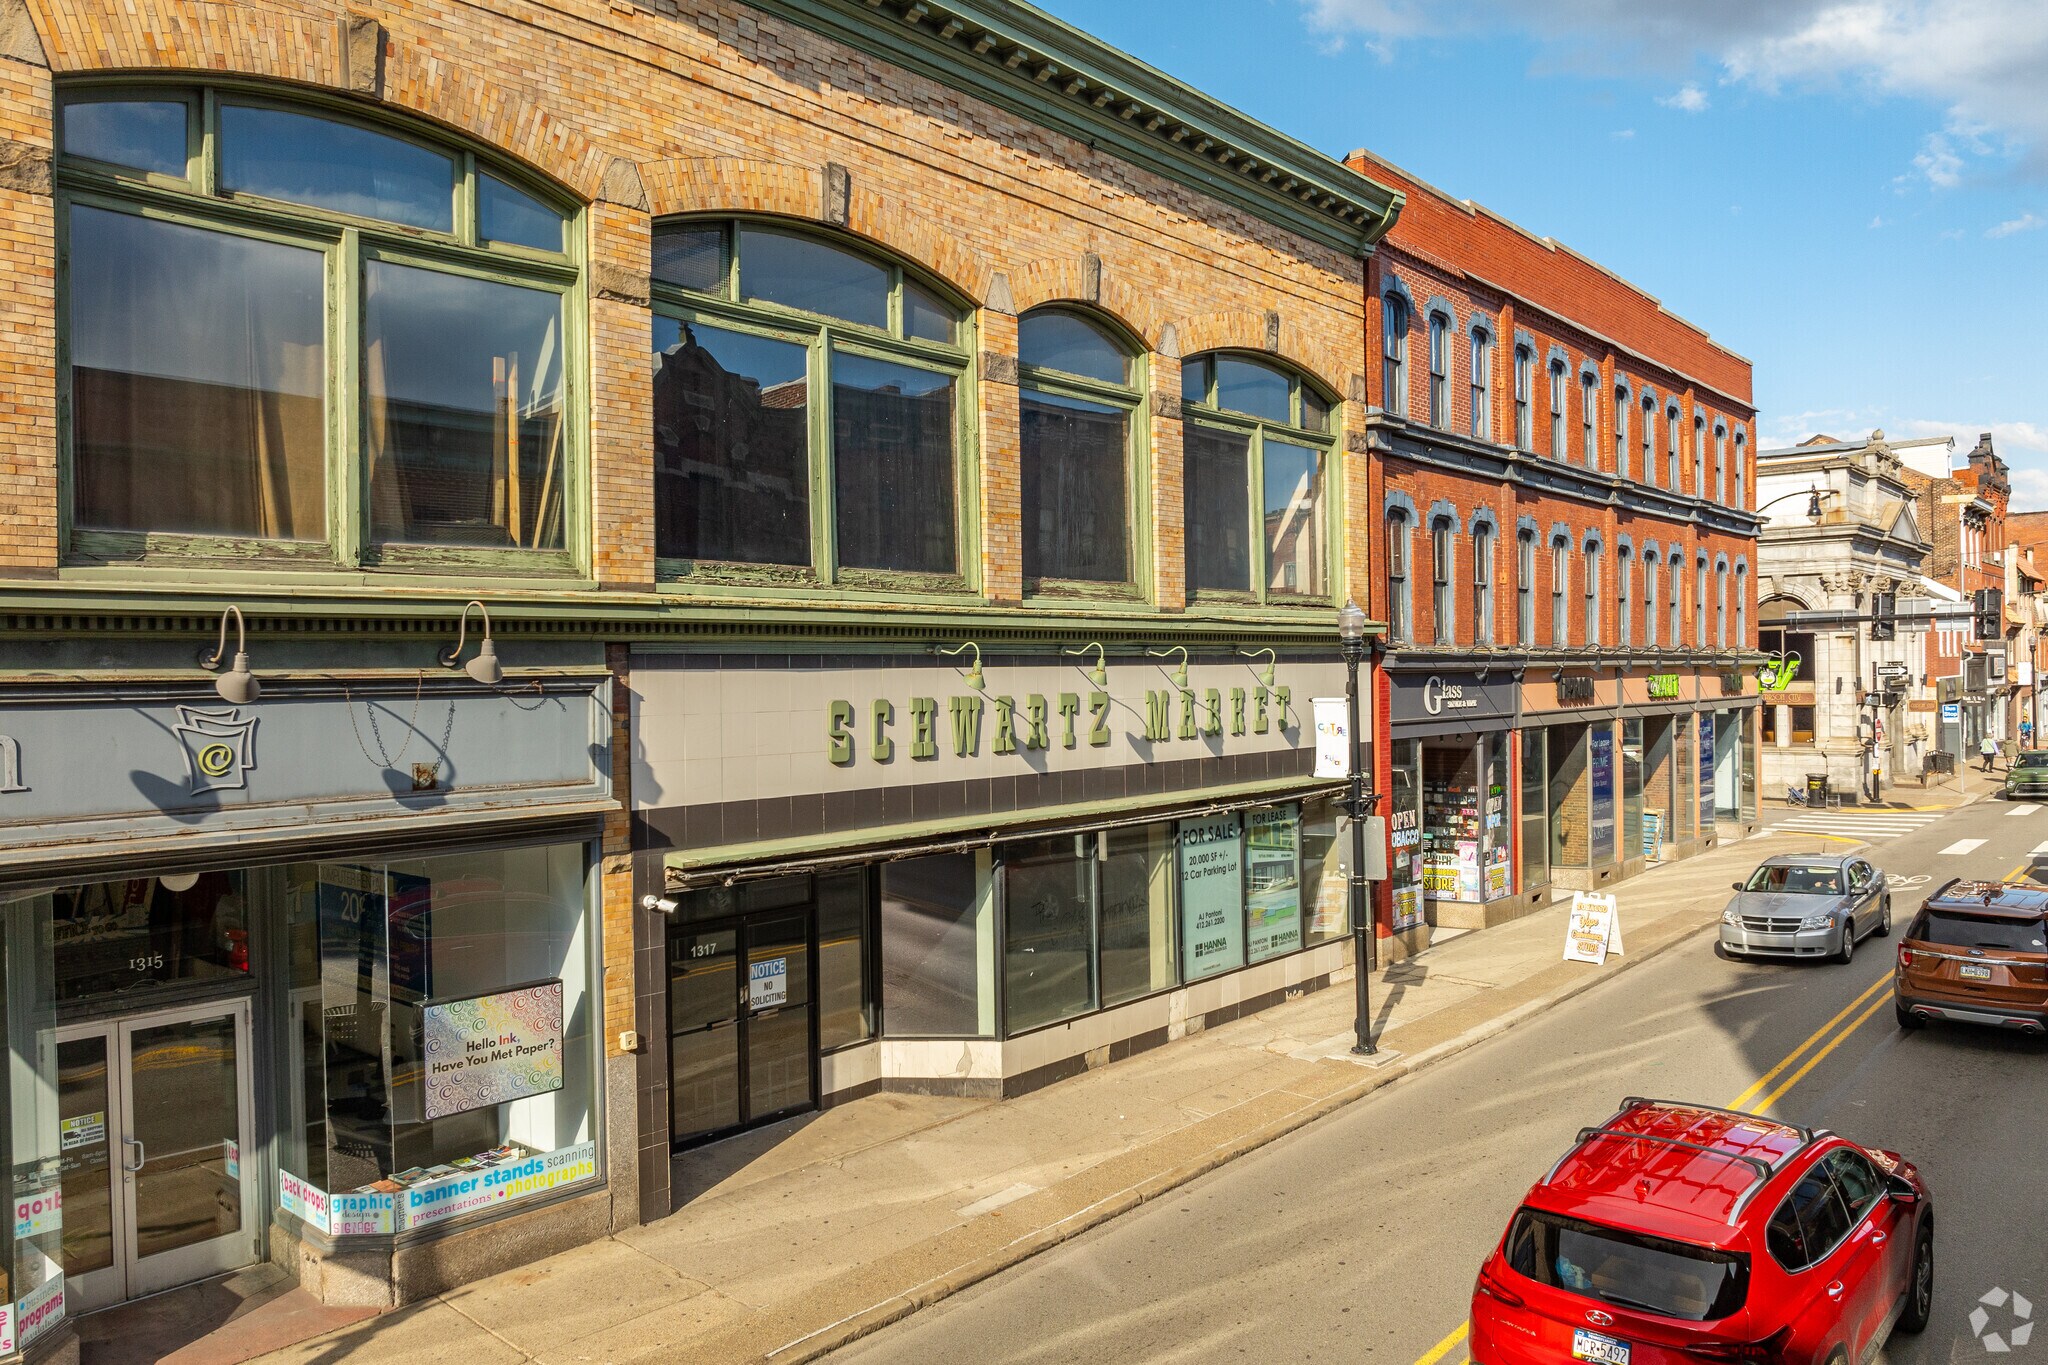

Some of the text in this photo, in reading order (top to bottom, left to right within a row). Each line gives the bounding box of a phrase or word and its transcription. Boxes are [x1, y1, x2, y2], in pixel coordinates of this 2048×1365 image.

[1424, 675, 1462, 715] Glass
[827, 685, 1291, 764] SCHWARTZ MARKET
[1252, 810, 1287, 825] FOR LEASE
[1391, 809, 1416, 831] OPEN
[1183, 823, 1234, 846] FOR SALE
[1391, 828, 1420, 848] OBACCO
[1188, 852, 1210, 867] 20,000
[1210, 851, 1218, 862] SF
[1190, 869, 1203, 880] Car
[1203, 864, 1227, 877] Parking
[1227, 862, 1237, 872] Lot
[1423, 876, 1455, 892] STORE
[1203, 936, 1227, 951] HANNA
[1278, 929, 1299, 942] HANNA
[690, 942, 717, 958] 1317
[128, 954, 164, 972] 1315
[751, 959, 785, 979] NOTICE
[763, 981, 773, 991] NO
[751, 991, 786, 1007] SOLICITING
[466, 1033, 520, 1053] Hello Ink,
[432, 1038, 555, 1074] Have You Met Paper?
[70, 1115, 96, 1128] NOTICE
[410, 1145, 594, 1208] banner stands scanning
[506, 1160, 594, 1200] photographs
[332, 1194, 393, 1214] graphic
[342, 1209, 371, 1222] design
[333, 1221, 378, 1234] SIGNAGE
[25, 1281, 59, 1310] business
[19, 1291, 63, 1338] programs
[20, 1312, 64, 1346] invitations
